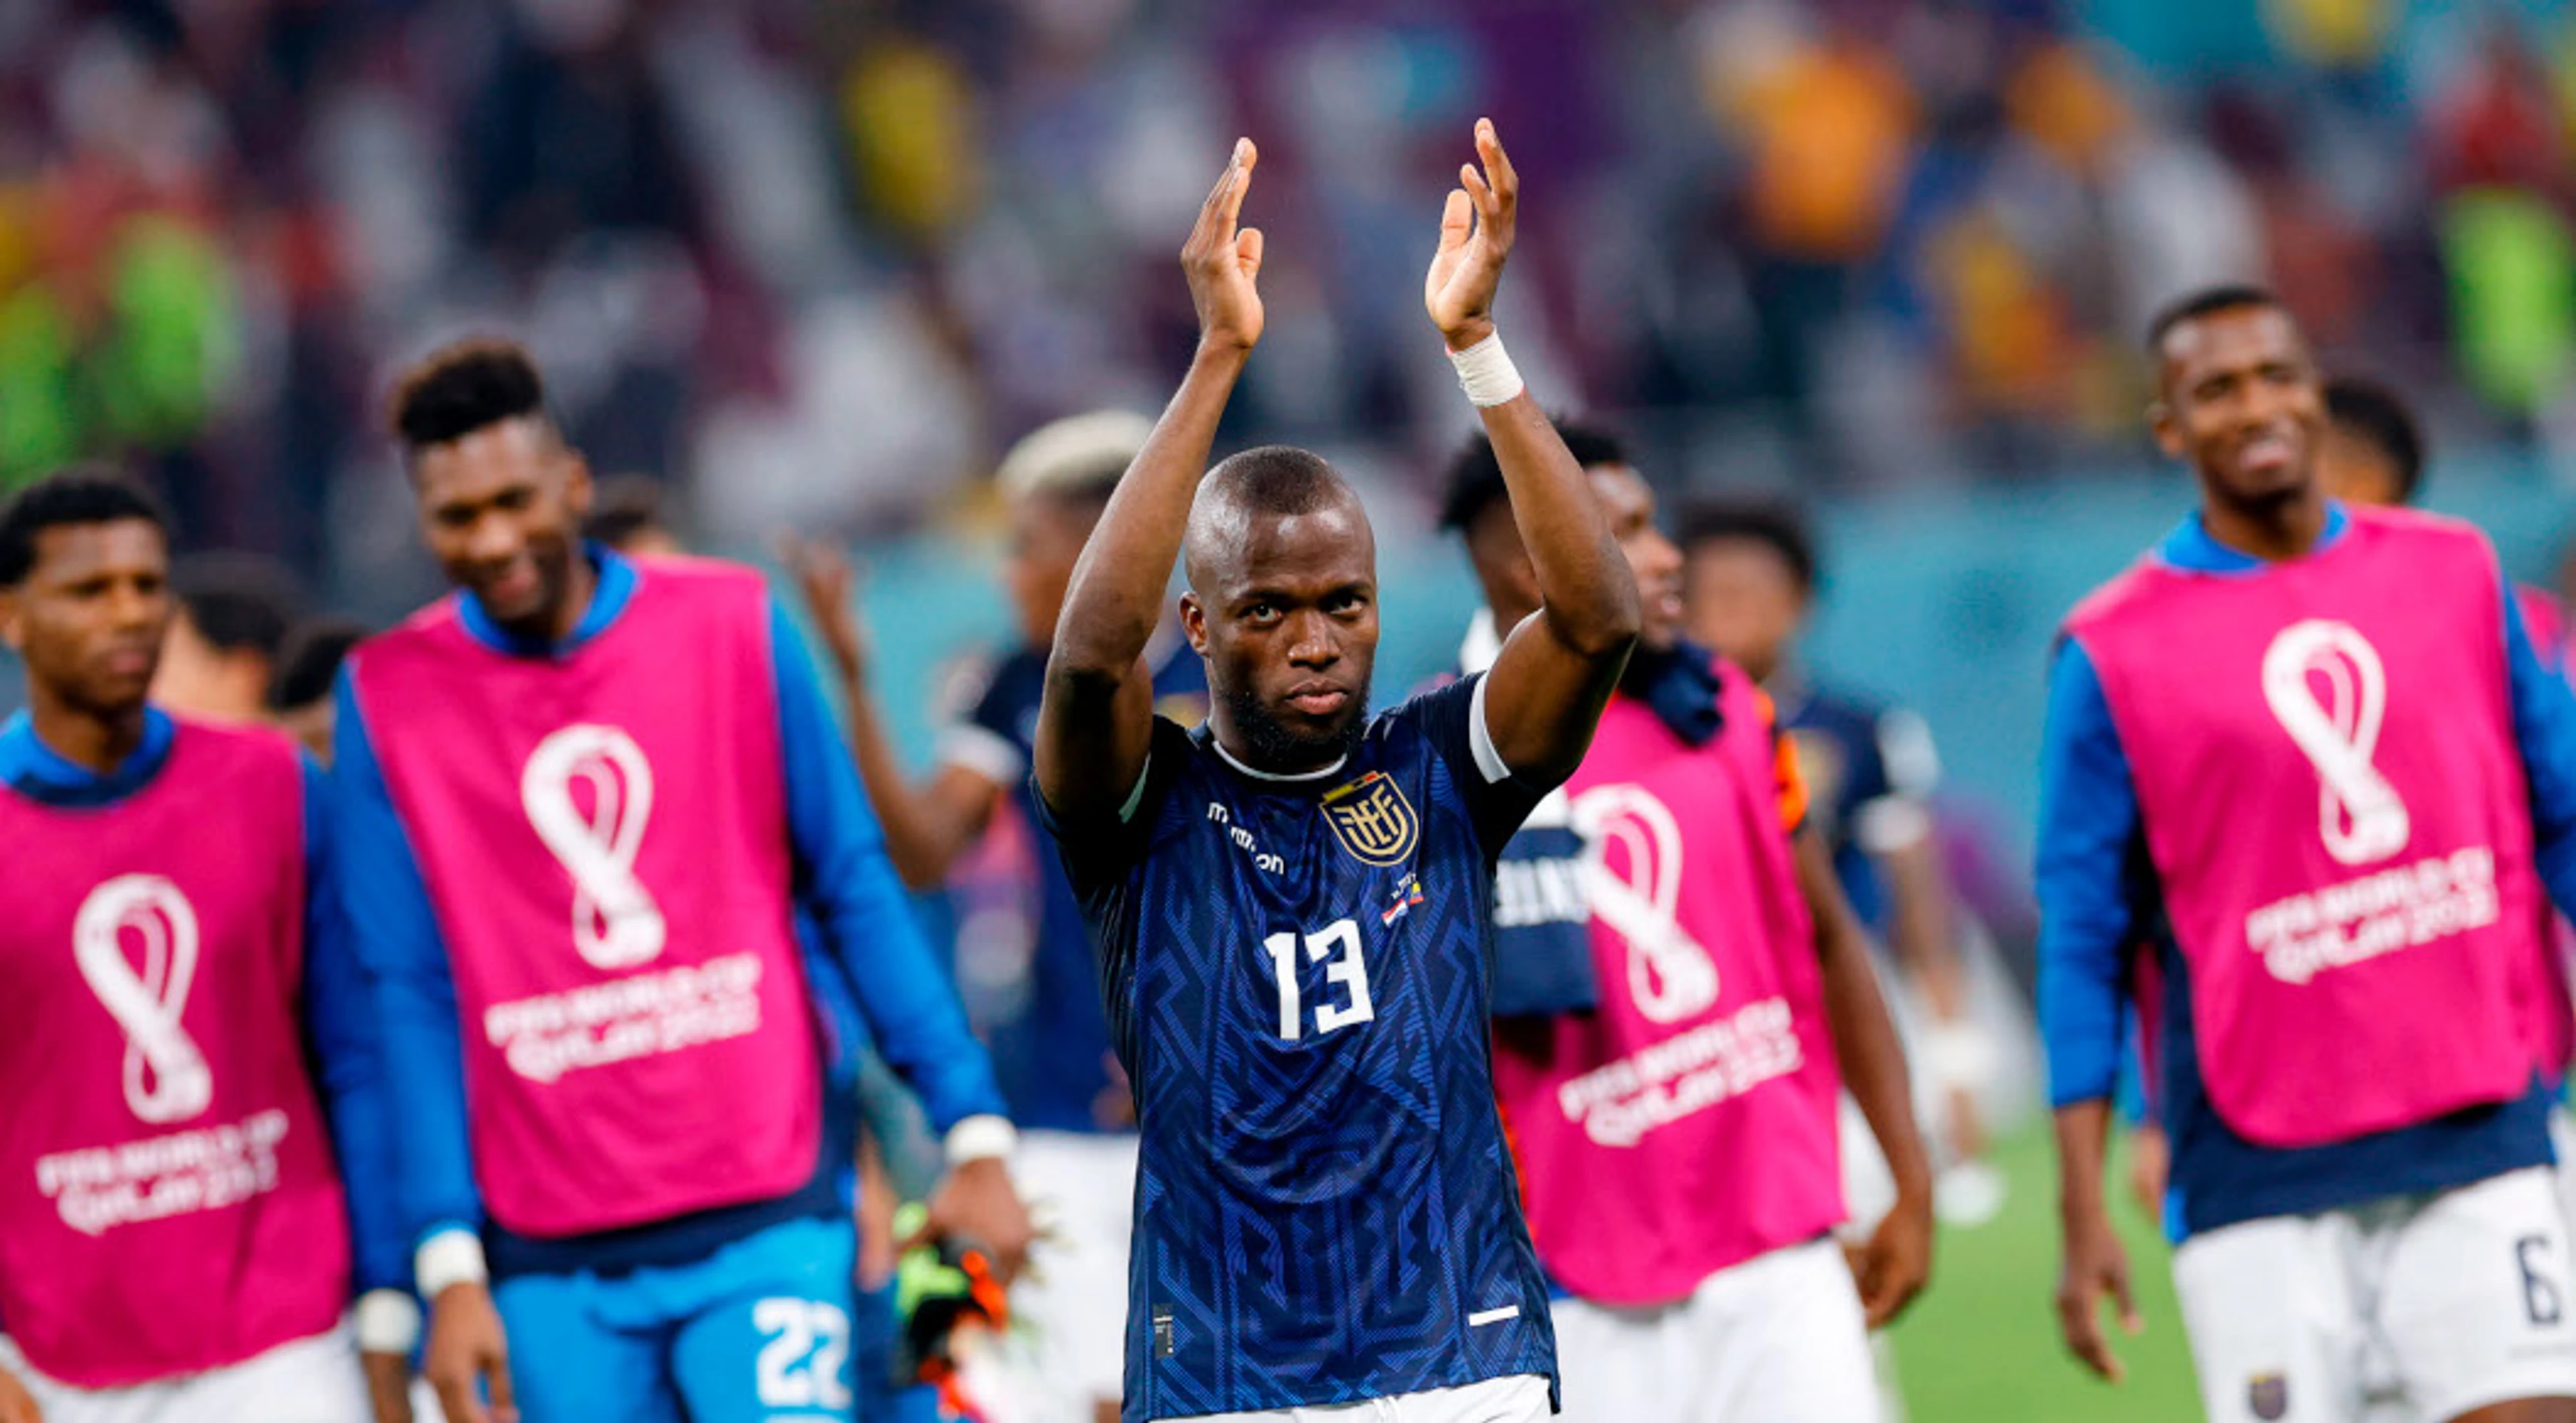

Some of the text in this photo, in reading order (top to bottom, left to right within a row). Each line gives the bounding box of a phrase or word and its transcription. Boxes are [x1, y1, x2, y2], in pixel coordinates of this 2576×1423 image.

[2315, 858, 2447, 922] WORLD
[564, 964, 698, 1029] WORLD
[1263, 918, 1374, 1040] 13
[113, 1124, 242, 1179] WORLD
[2513, 1234, 2561, 1326] 6
[753, 1296, 853, 1410] 22
